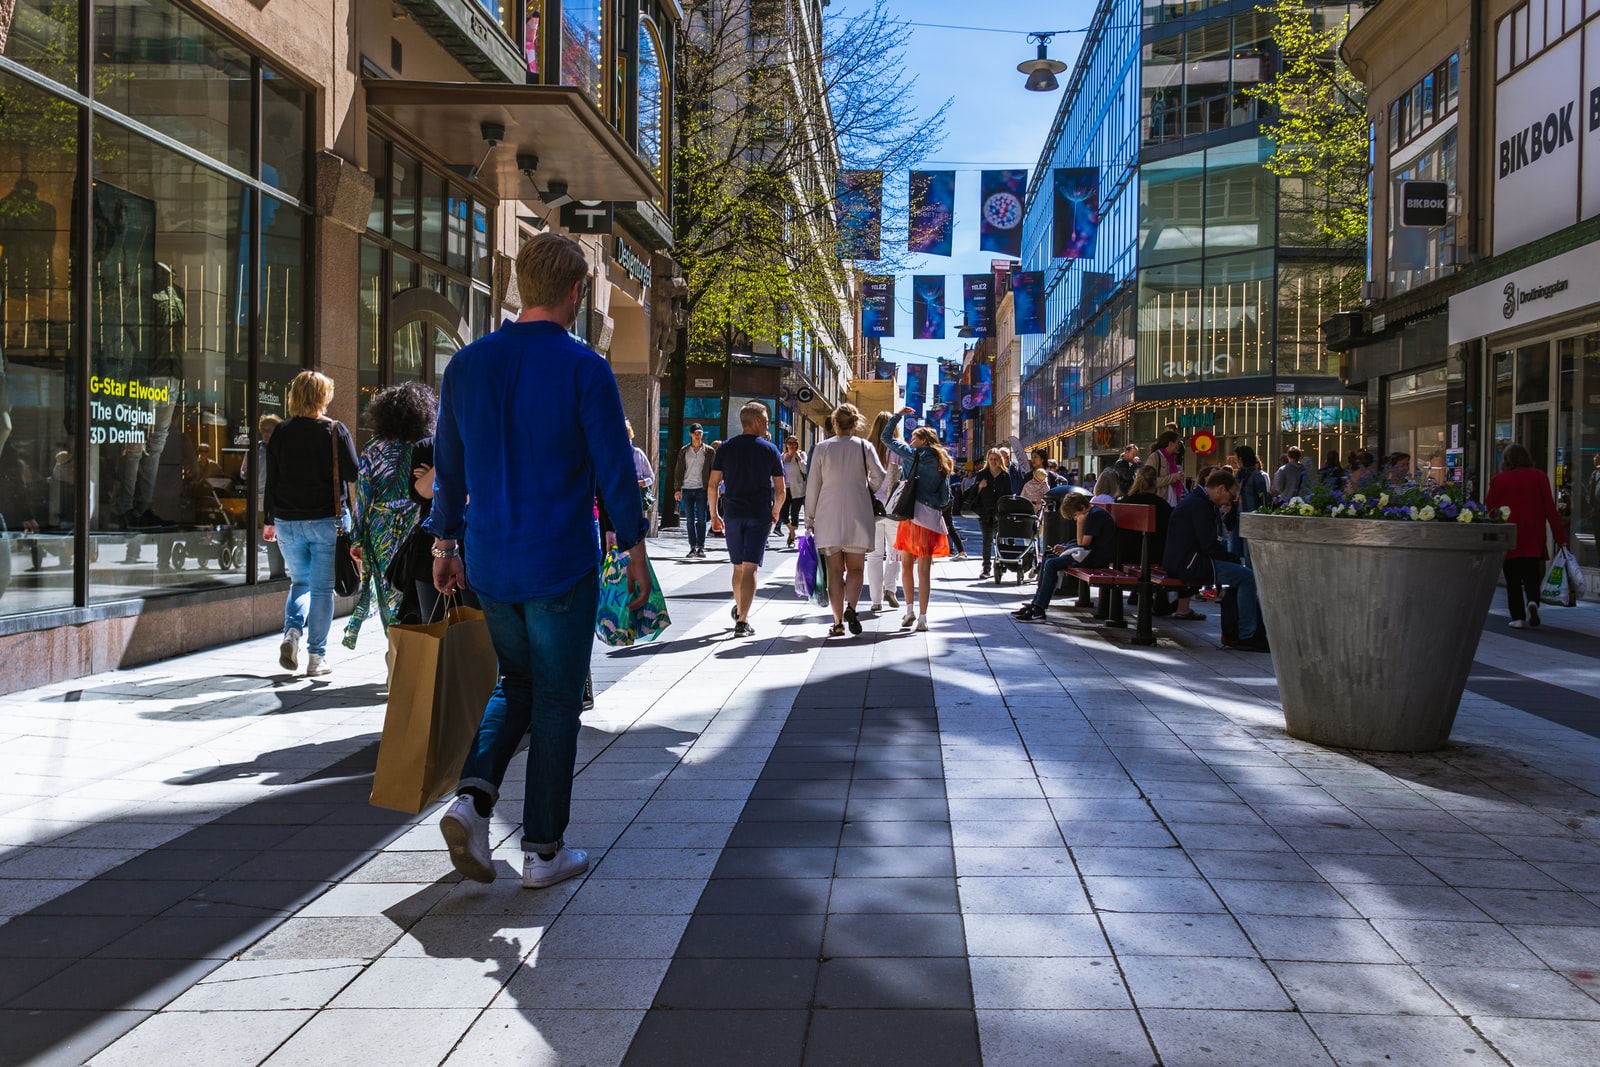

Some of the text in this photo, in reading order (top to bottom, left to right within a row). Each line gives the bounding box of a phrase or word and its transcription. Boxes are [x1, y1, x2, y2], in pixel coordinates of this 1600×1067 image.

[1520, 279, 1568, 304] Drottninggatan
[90, 376, 169, 402] G-Star Elwood
[258, 391, 280, 403] ollection
[91, 402, 156, 425] The Original
[1180, 412, 1215, 428] WEEKDAY
[90, 427, 146, 444] 3D Denim
